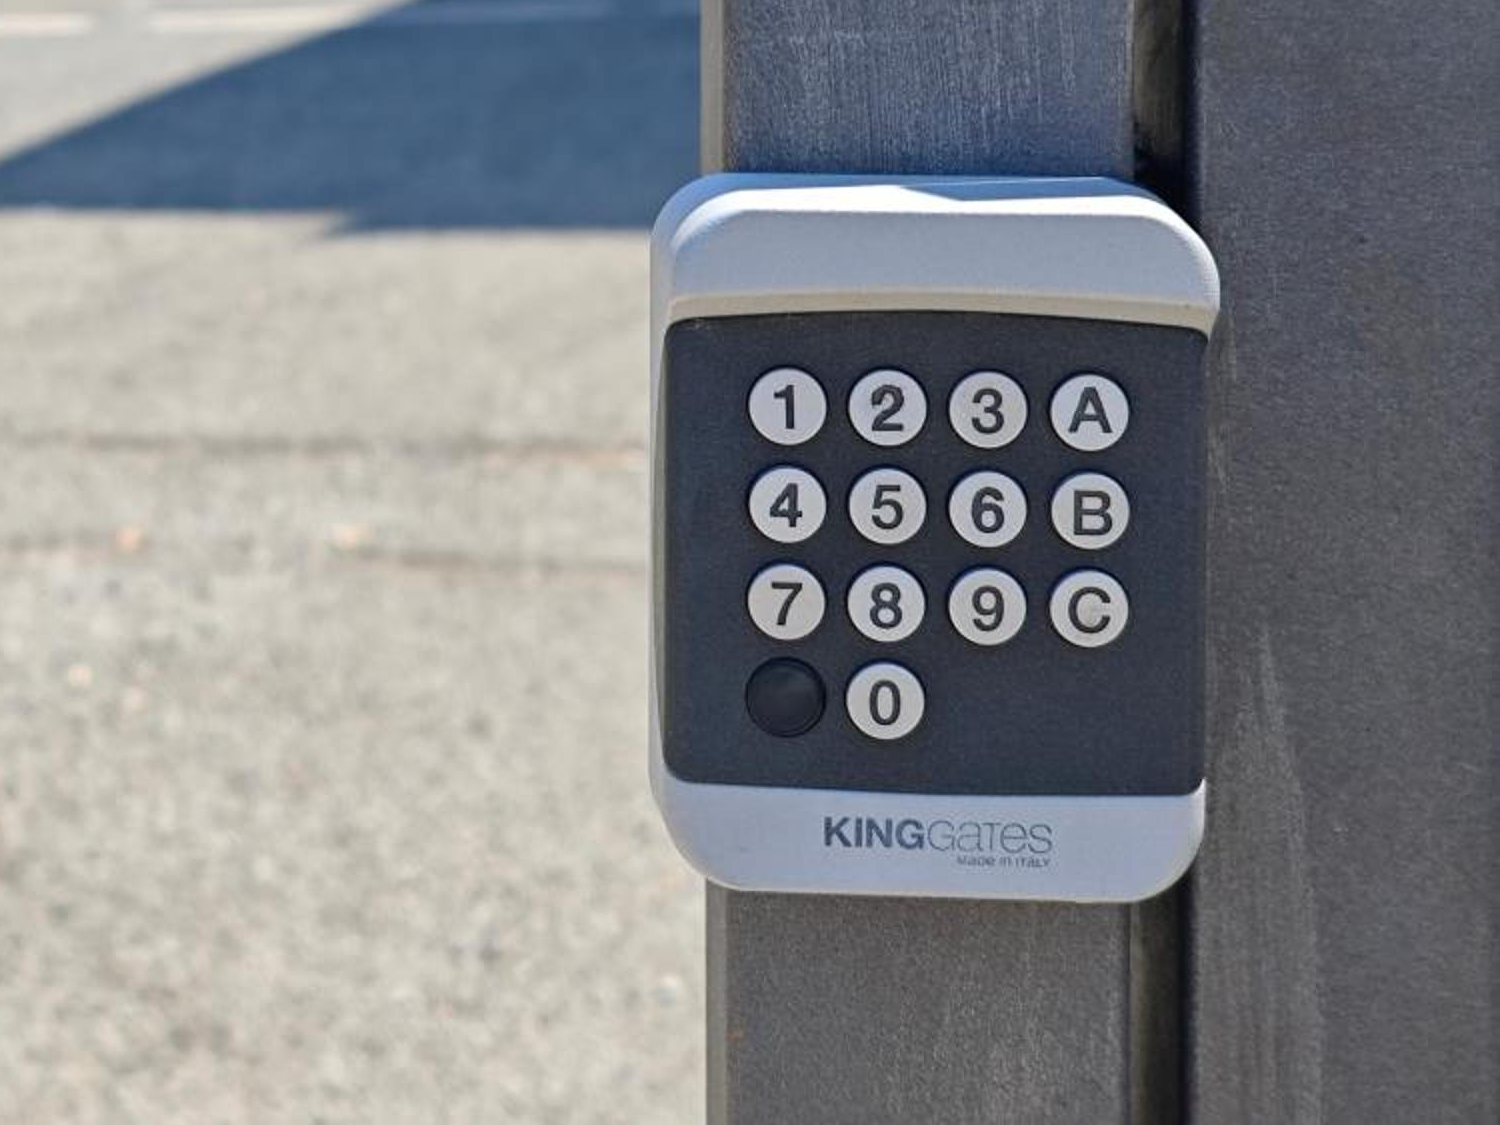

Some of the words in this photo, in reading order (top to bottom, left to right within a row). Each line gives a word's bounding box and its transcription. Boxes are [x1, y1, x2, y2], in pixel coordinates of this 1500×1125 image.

[773, 384, 795, 430] 1
[870, 384, 905, 432] 2
[971, 387, 1005, 435] 3
[1067, 386, 1113, 434] A
[769, 482, 803, 528] 4
[871, 484, 905, 531] 5
[970, 486, 1005, 534] 6
[1073, 489, 1113, 537] B
[770, 581, 803, 627] 7
[869, 582, 903, 630] 8
[971, 585, 1005, 633] 9
[1067, 586, 1112, 635] C
[868, 679, 902, 726] 0
